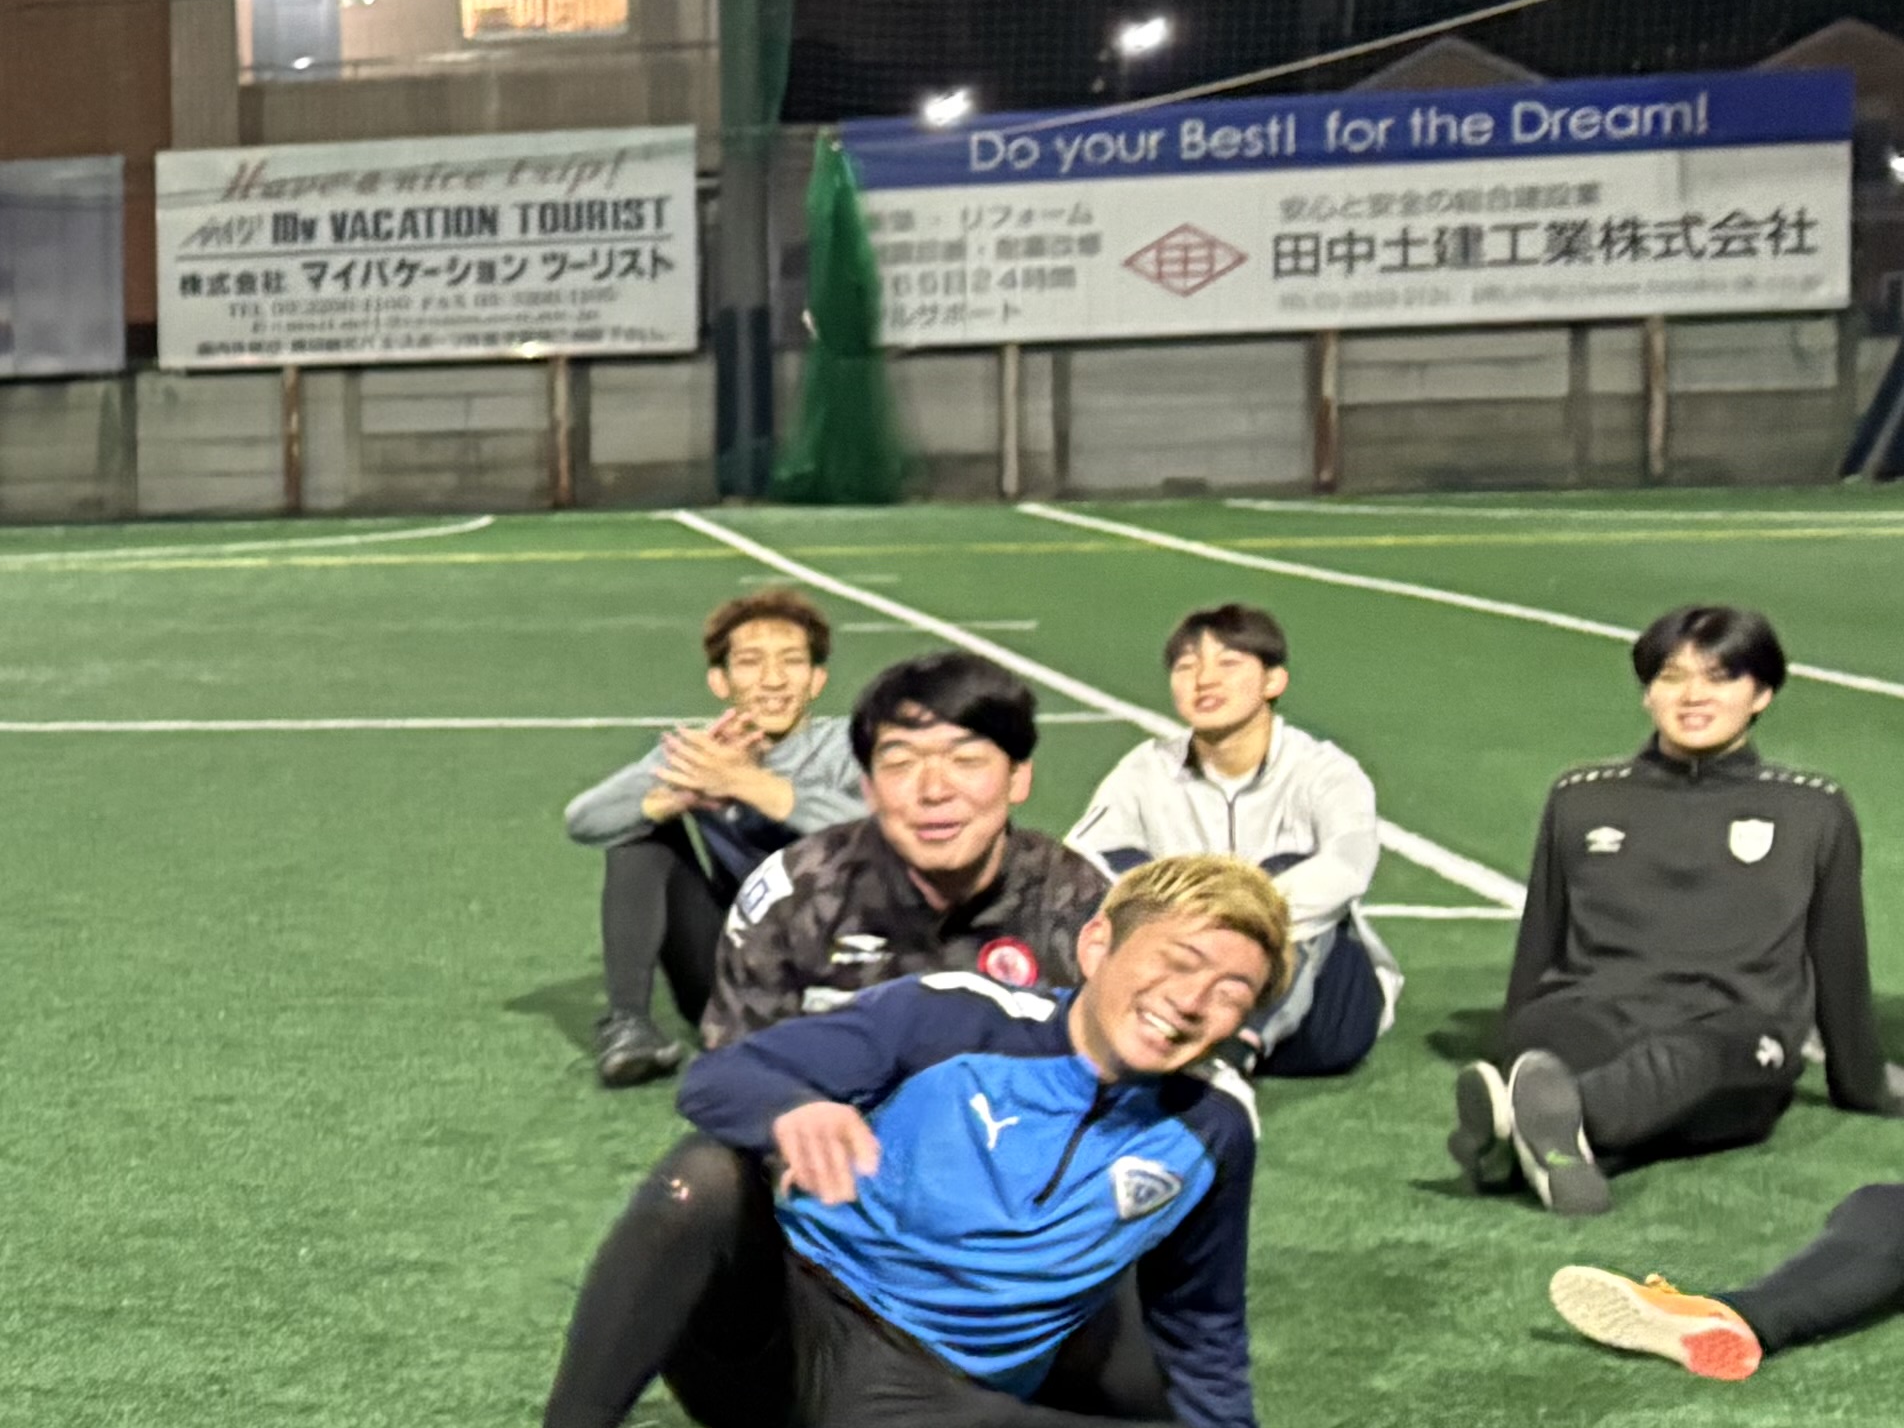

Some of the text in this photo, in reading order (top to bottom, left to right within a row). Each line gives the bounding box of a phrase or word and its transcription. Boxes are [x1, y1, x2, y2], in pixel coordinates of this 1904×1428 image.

[969, 129, 1040, 172] Do
[1054, 127, 1165, 173] your
[1325, 109, 1395, 153] for
[1410, 106, 1495, 148] the
[1511, 91, 1709, 145] Dream!
[329, 204, 500, 244] VACATION
[513, 194, 672, 237] TOURIST
[1273, 206, 1819, 278] 田中土建工業株式会社
[300, 253, 530, 292] マイバケーション
[541, 244, 675, 283] ツーリスト
